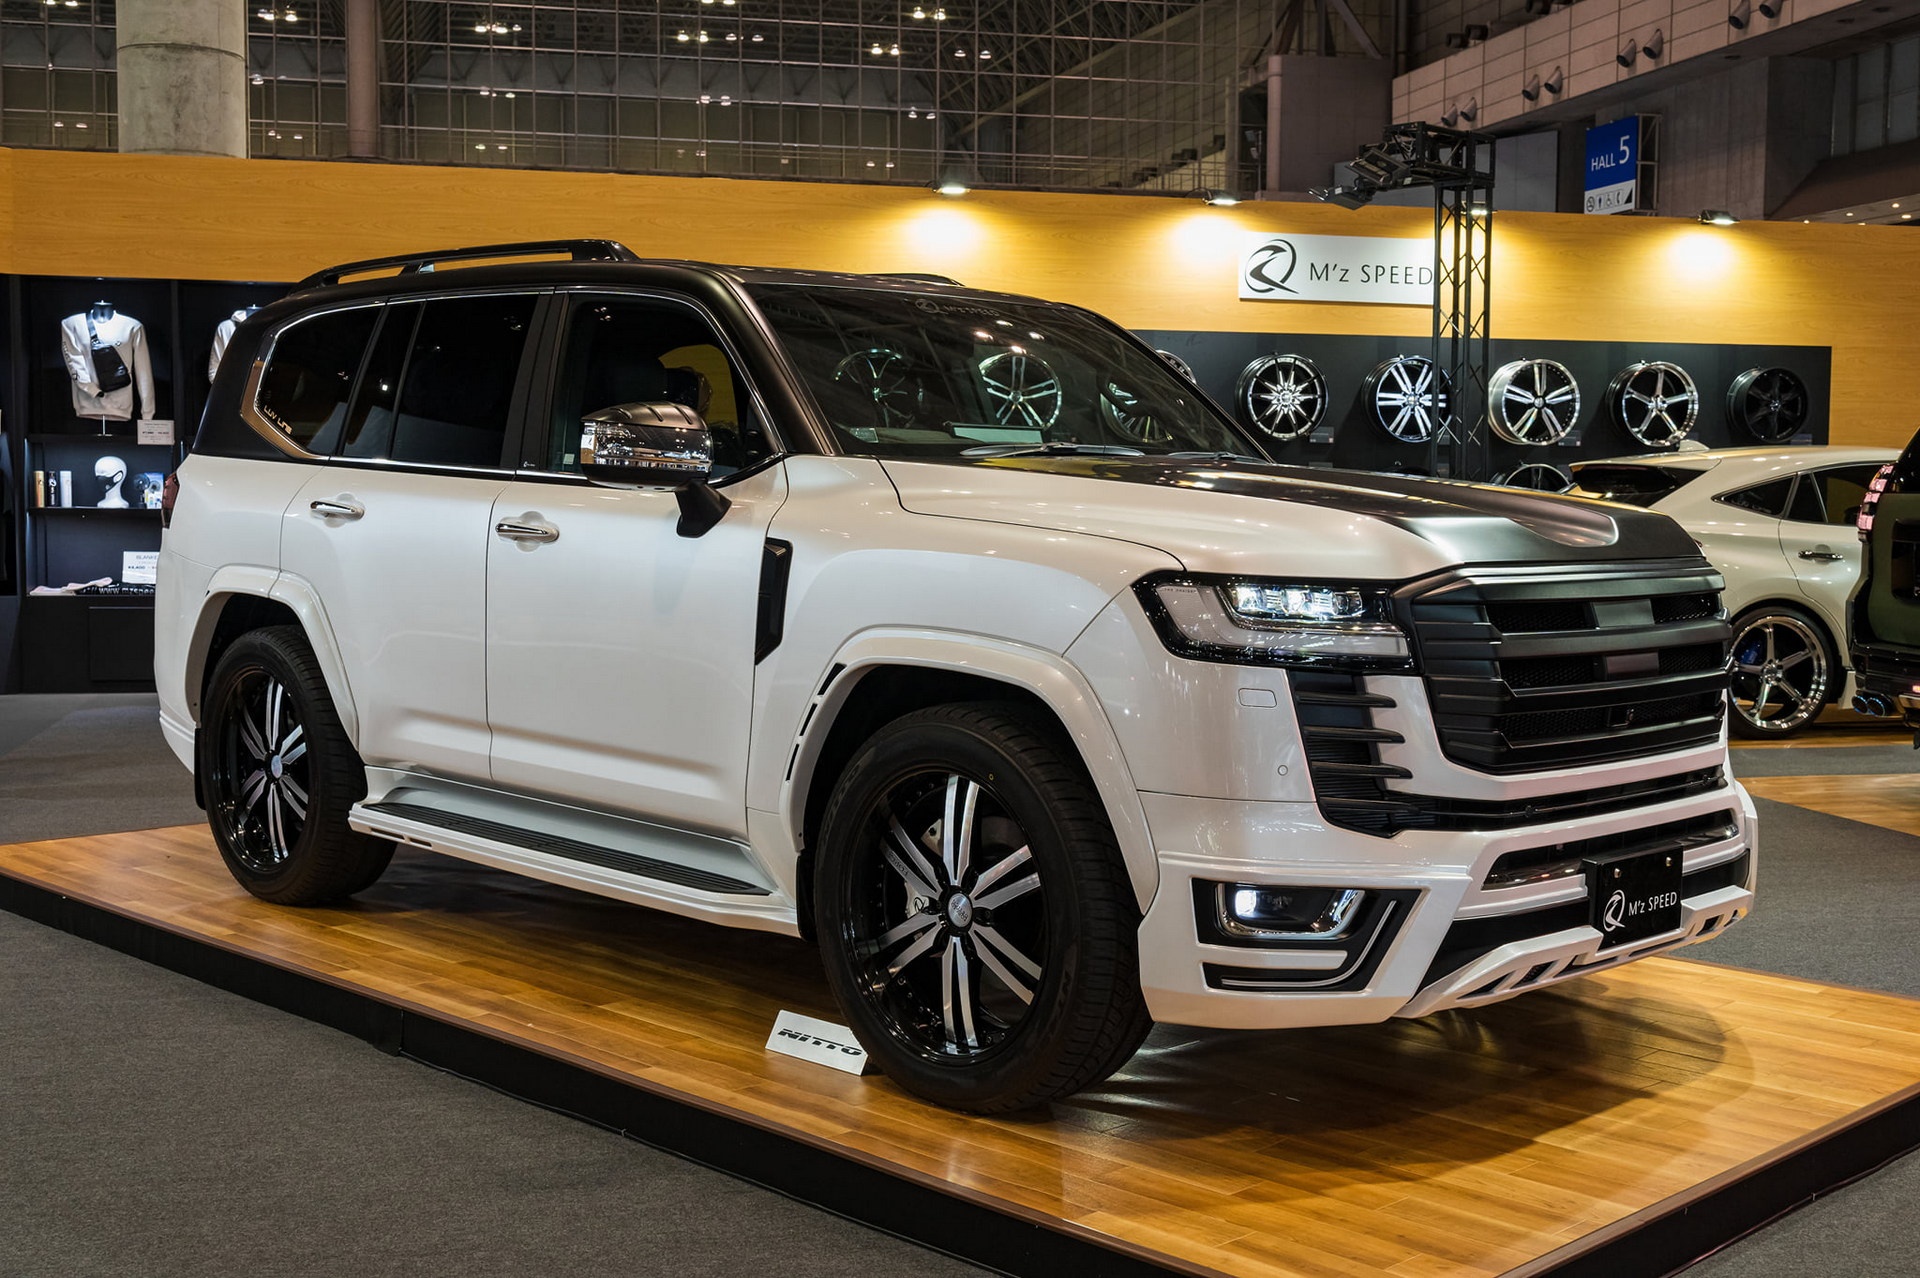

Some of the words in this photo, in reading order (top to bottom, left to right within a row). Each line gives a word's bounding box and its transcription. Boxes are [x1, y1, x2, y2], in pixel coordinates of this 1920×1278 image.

[1591, 152, 1616, 172] HALL
[1619, 134, 1630, 165] 5
[1309, 262, 1350, 283] M'z
[1360, 264, 1433, 286] SPEED
[1628, 900, 1645, 916] M'z
[1648, 891, 1677, 911] SPEED
[777, 1028, 862, 1056] NITTO
